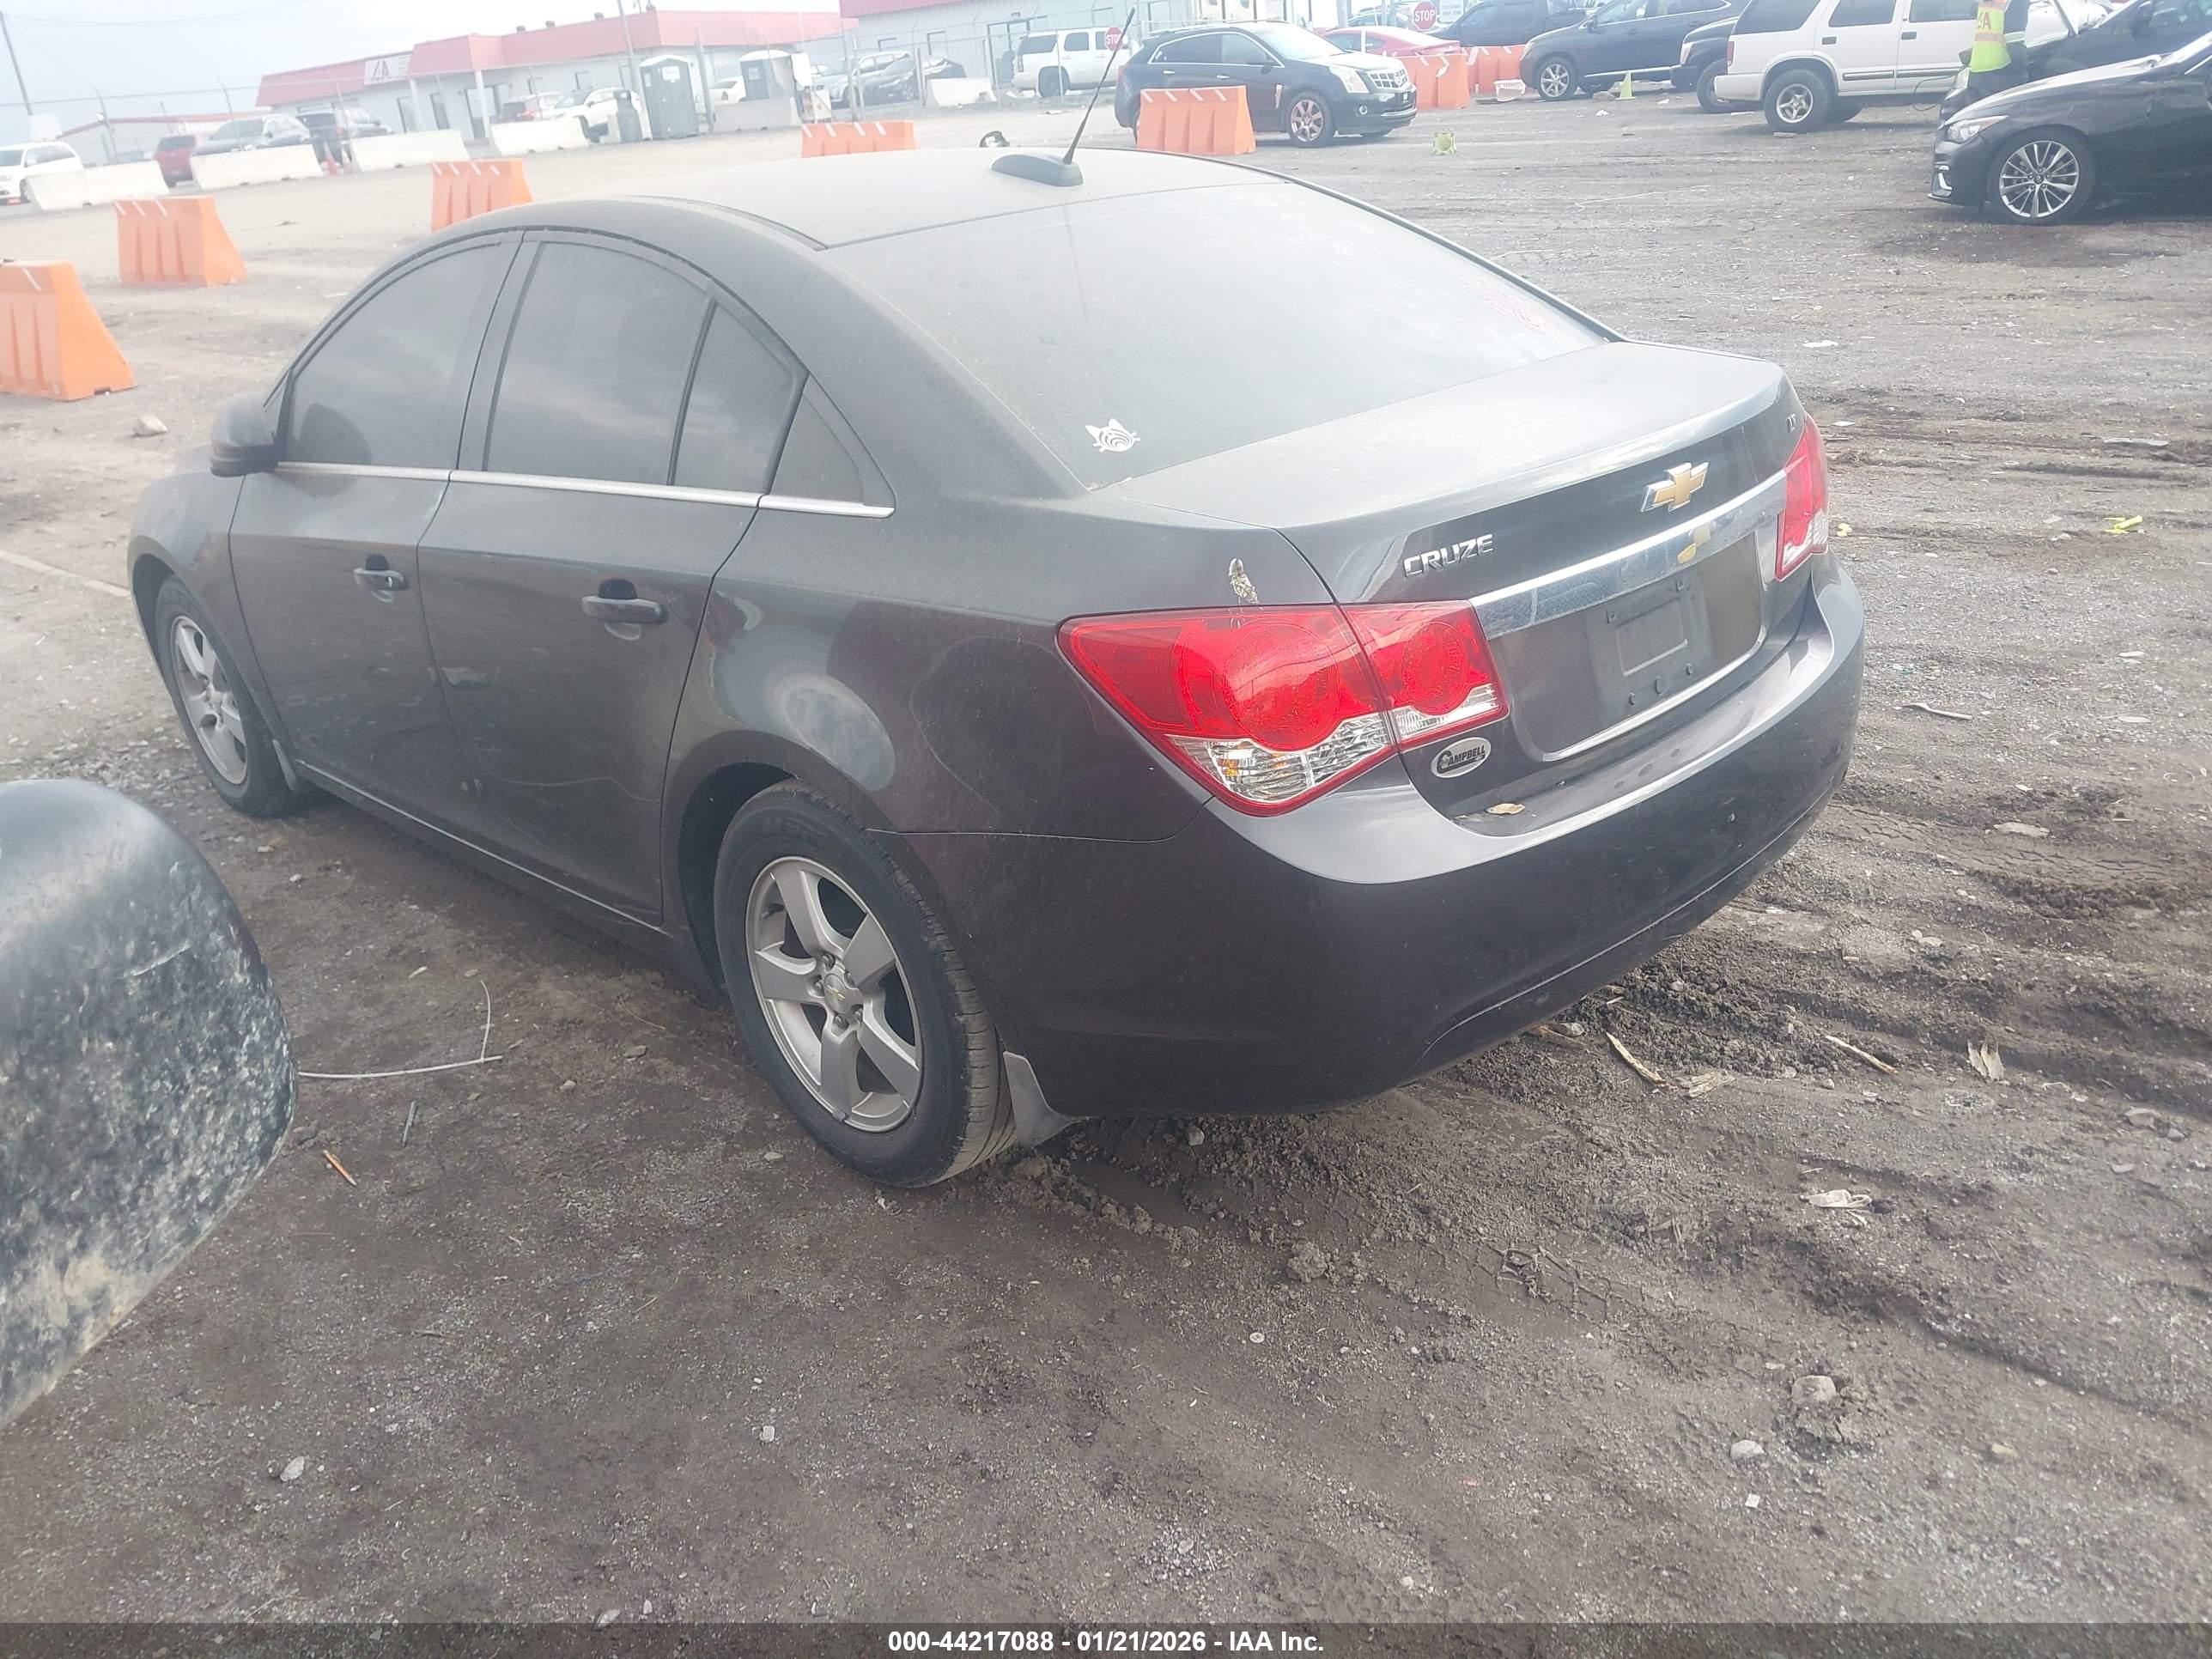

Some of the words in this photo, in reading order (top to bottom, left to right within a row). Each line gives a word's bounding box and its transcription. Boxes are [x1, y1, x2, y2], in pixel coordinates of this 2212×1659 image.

[1414, 9, 1436, 21] STOP
[1106, 34, 1121, 45] STO
[1404, 533, 1494, 577] CRUZE
[1437, 745, 1486, 774] CAMPBELL
